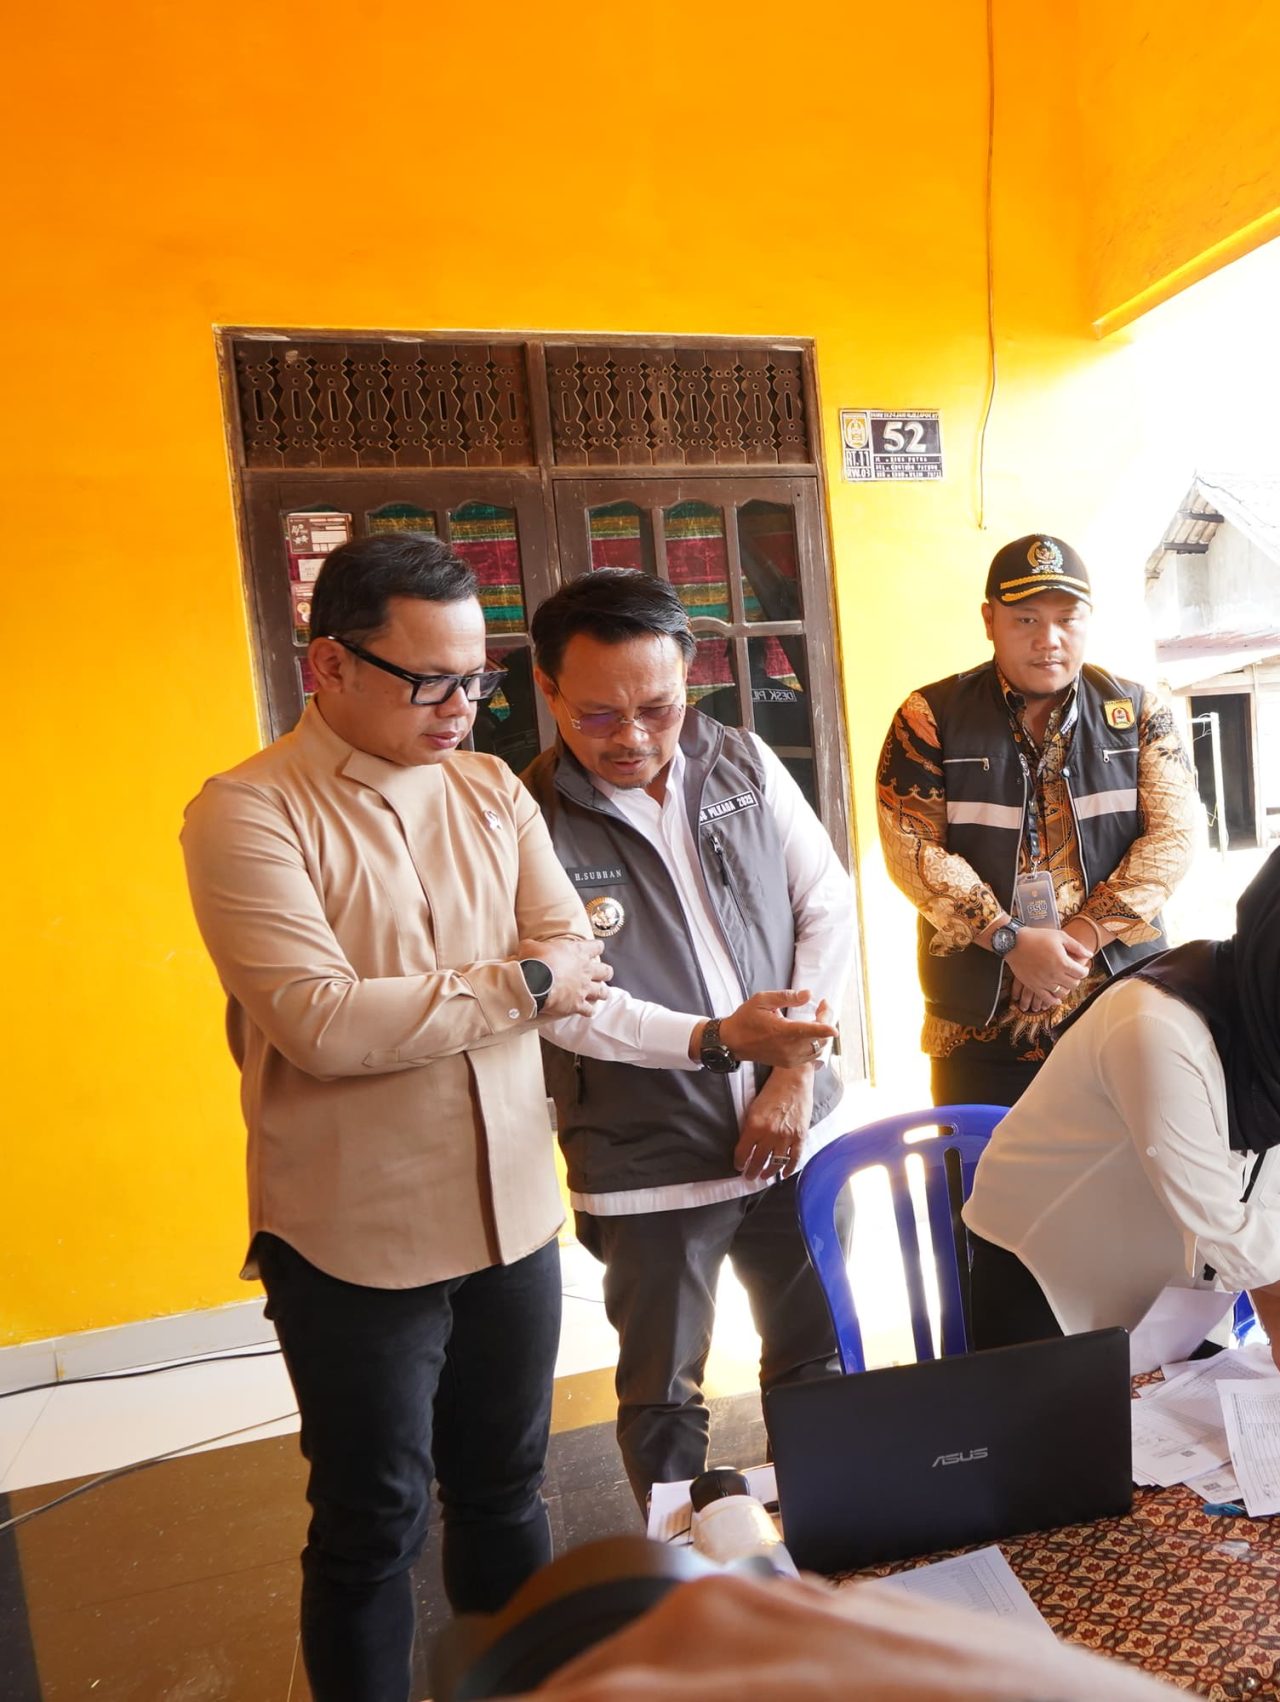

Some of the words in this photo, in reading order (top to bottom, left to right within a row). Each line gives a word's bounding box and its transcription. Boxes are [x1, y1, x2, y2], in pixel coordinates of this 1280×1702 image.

[883, 421, 927, 453] 52
[707, 800, 736, 818] PILKADA
[736, 794, 754, 807] 2025
[932, 1447, 988, 1468] ASUS
